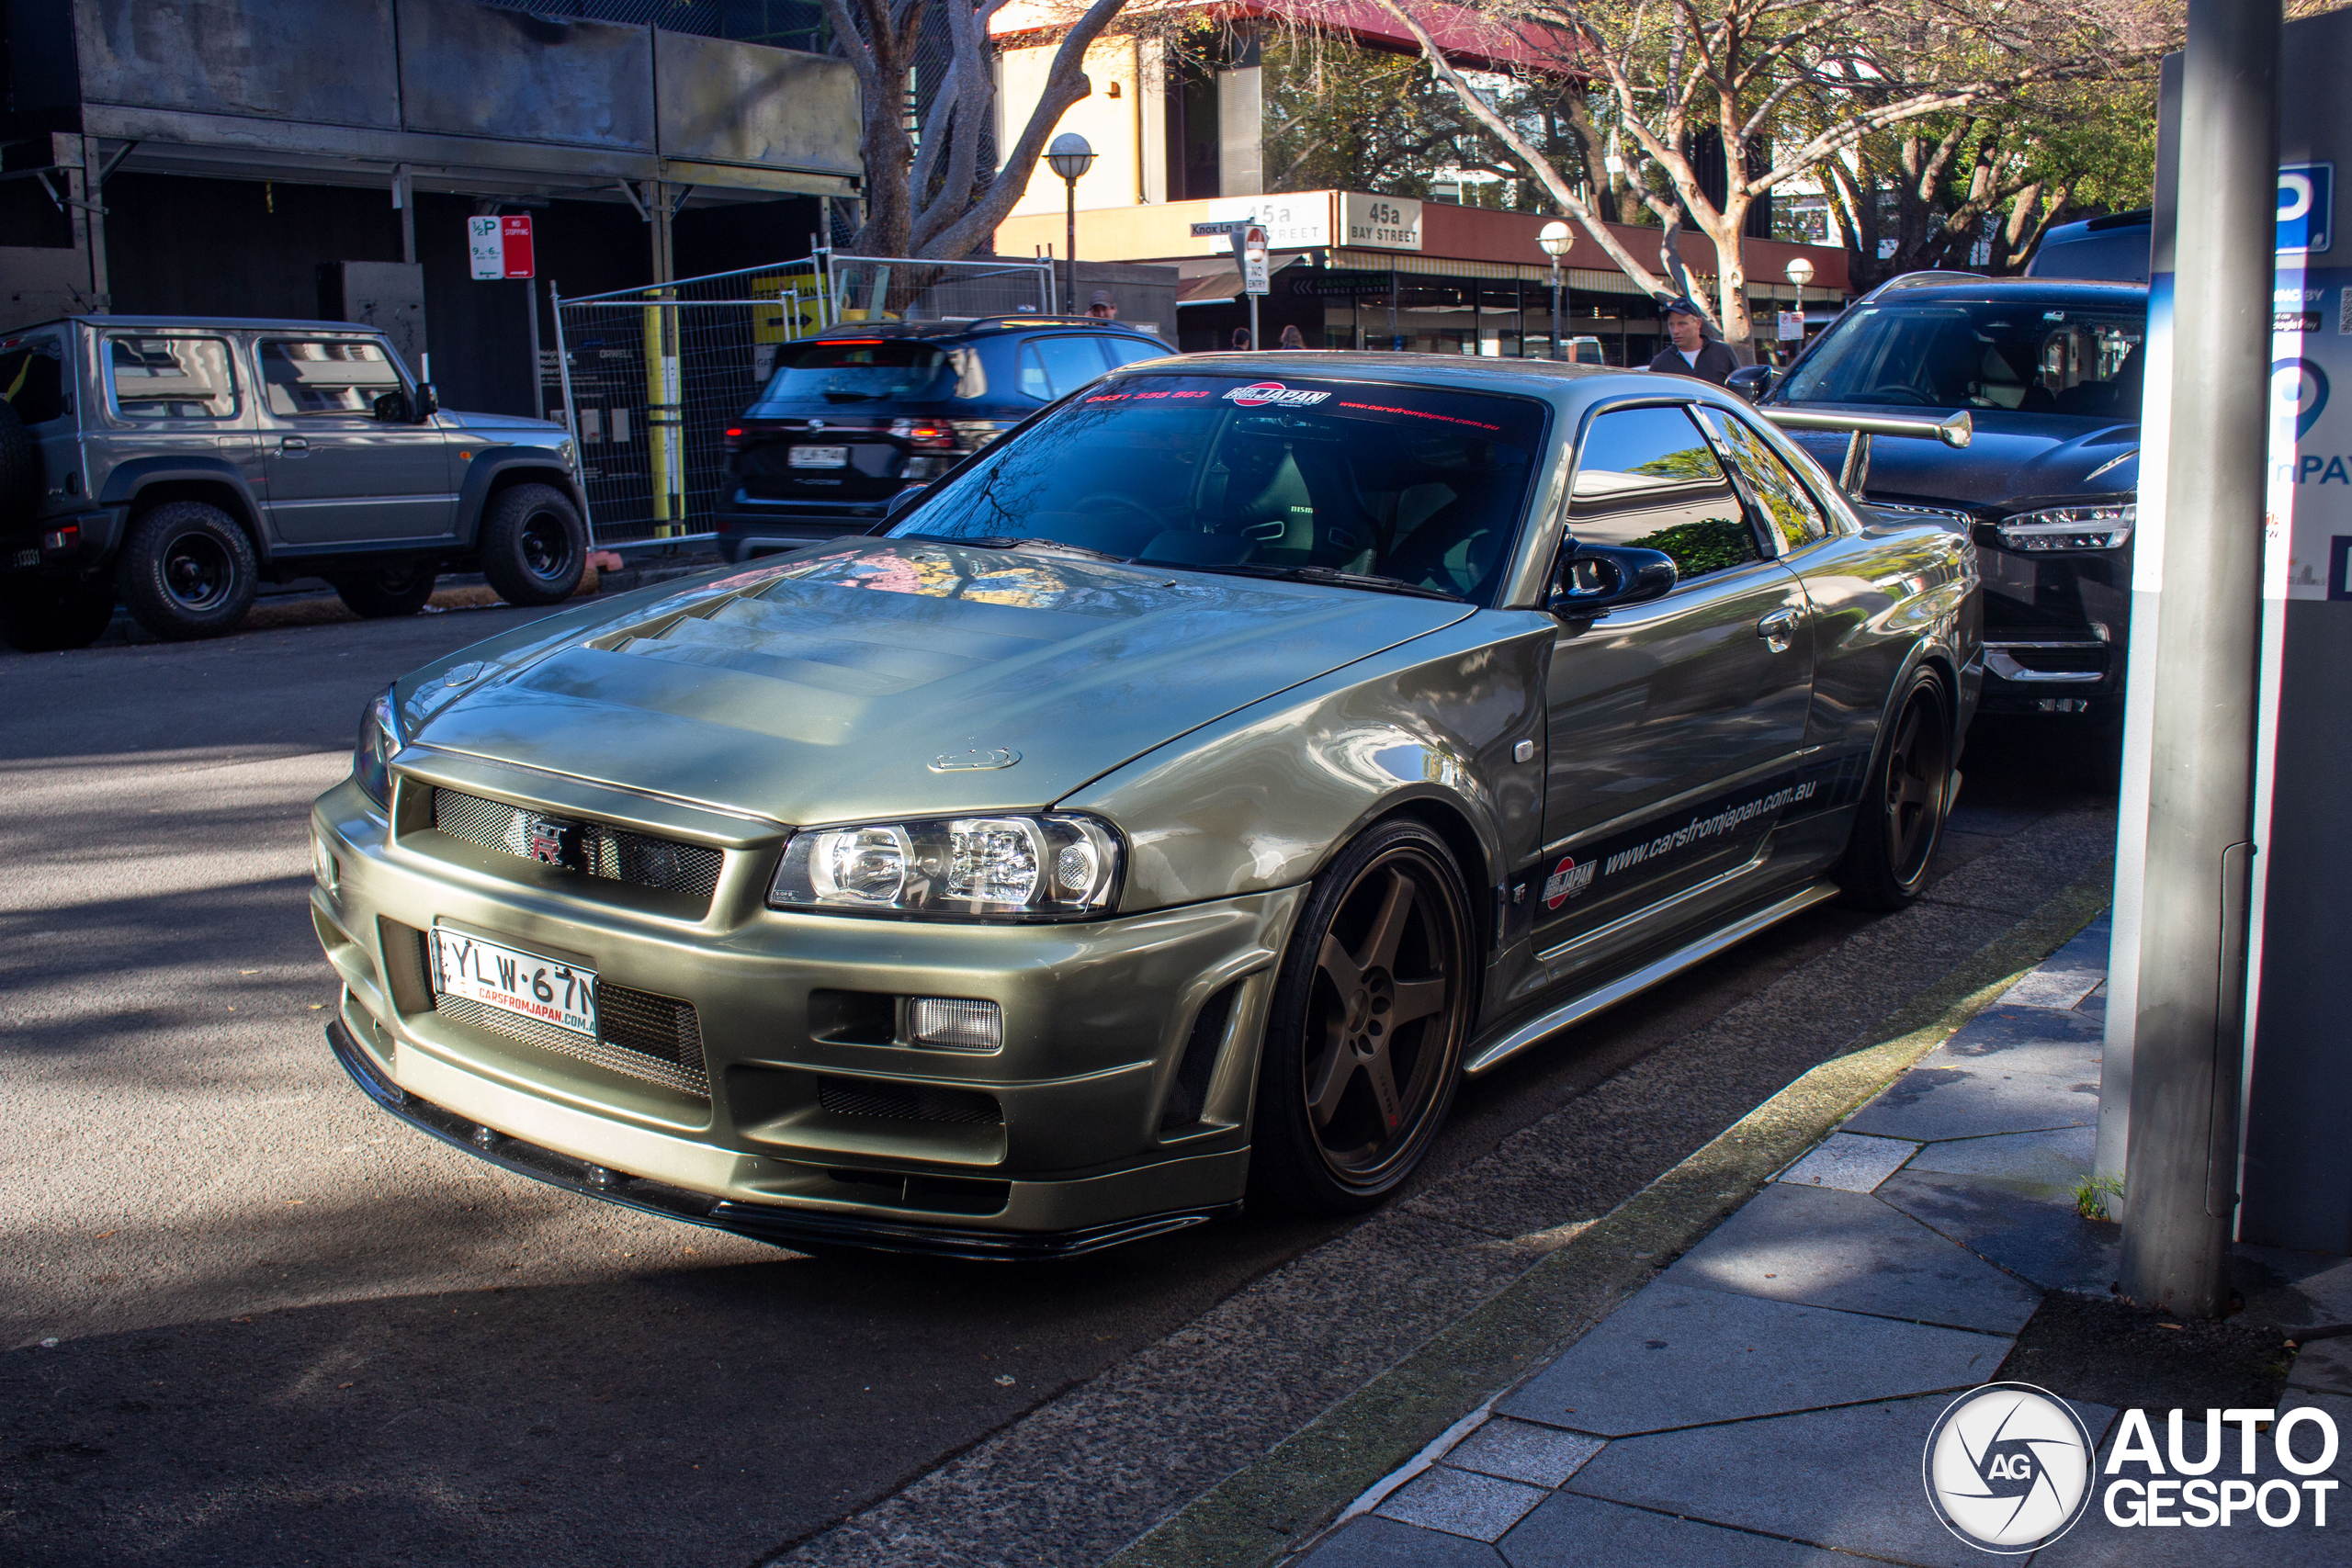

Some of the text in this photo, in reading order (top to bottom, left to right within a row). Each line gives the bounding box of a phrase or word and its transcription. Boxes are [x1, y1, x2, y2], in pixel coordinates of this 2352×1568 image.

[1247, 205, 1291, 224] 45a
[1370, 203, 1400, 224] 45a
[504, 228, 529, 236] STOPPING
[1192, 223, 1232, 234] Knox Ln
[1269, 226, 1318, 241] TREET
[1351, 226, 1417, 243] BAY STREET
[1251, 266, 1262, 276] NO
[1317, 277, 1390, 288] GRAND SLAM
[1355, 286, 1390, 294] CENTRE
[2304, 288, 2324, 301] BY
[599, 349, 633, 358] ORWELL
[1256, 389, 1326, 403] JAPAN
[1339, 400, 1501, 431] www.carsfromjapan.com.au
[1604, 781, 1817, 876] www.carsfromjapan.com.au
[1559, 862, 1596, 893] JAPAN
